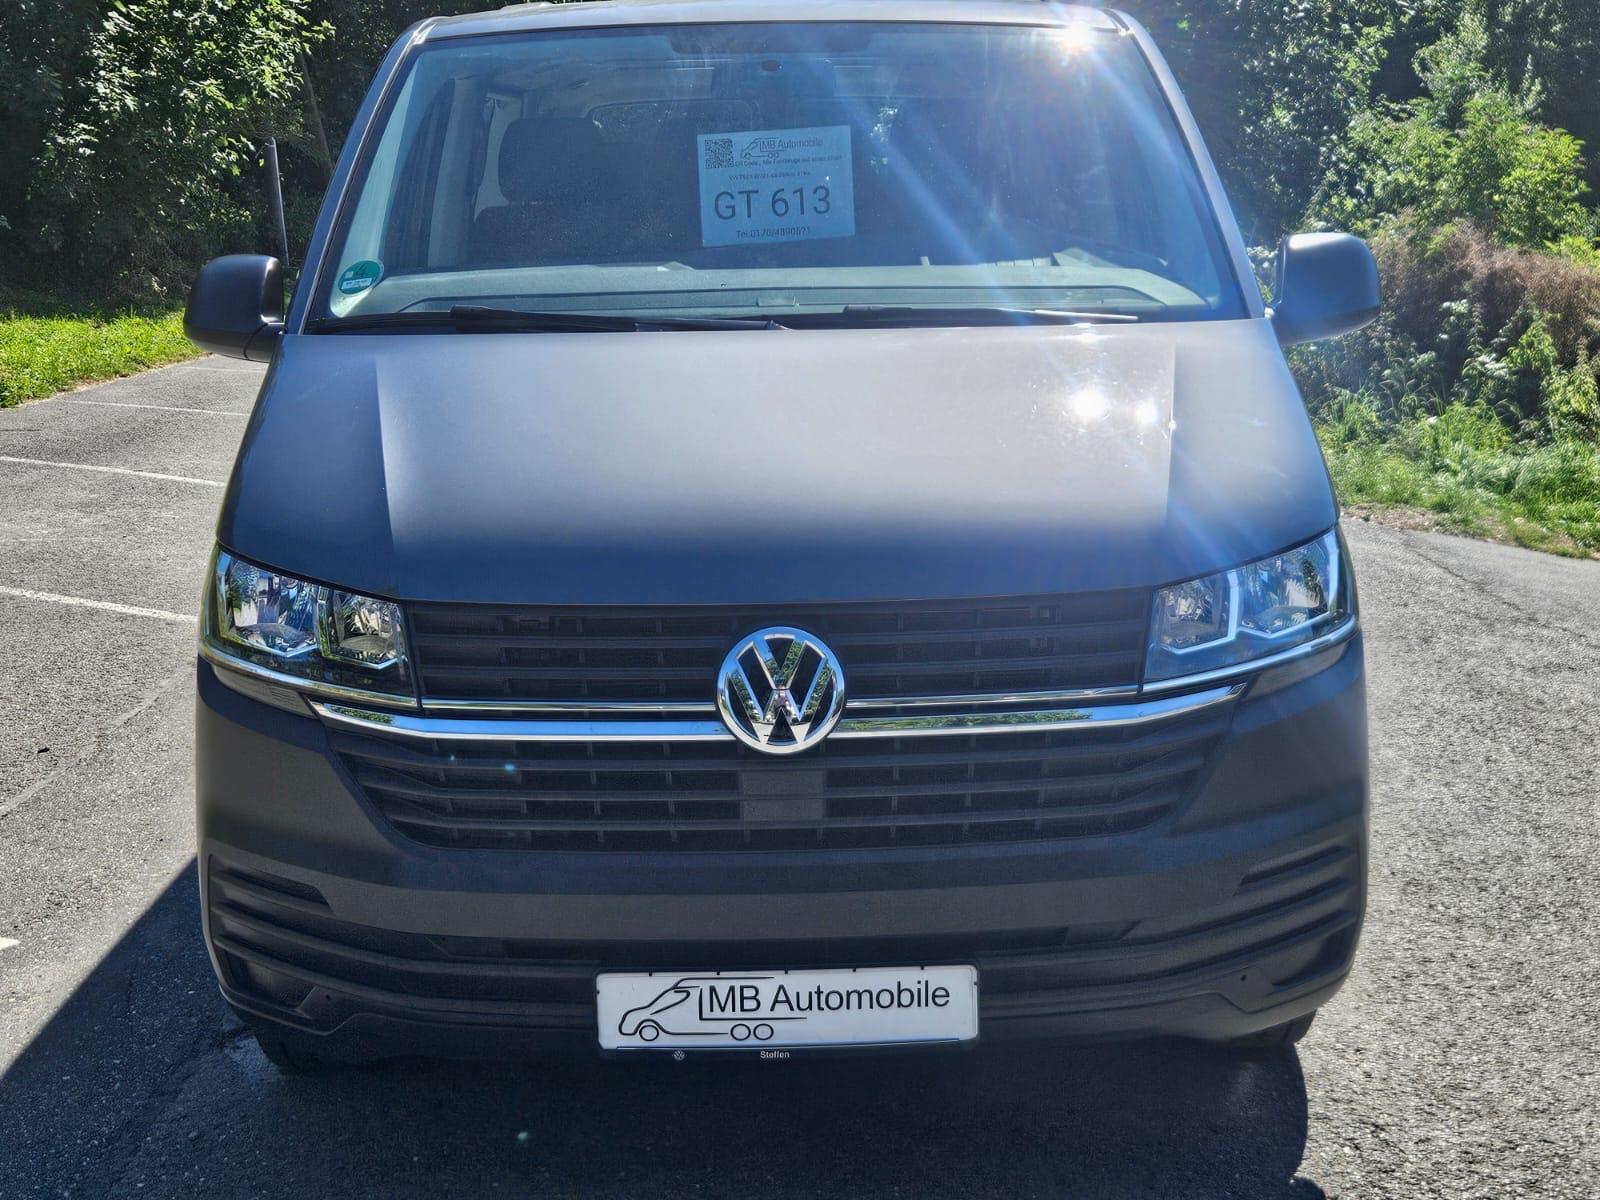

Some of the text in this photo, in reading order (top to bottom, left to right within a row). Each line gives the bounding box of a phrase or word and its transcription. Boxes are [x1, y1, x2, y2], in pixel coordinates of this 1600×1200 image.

[762, 137, 823, 149] MB Automobile
[714, 184, 831, 220] GT 613
[709, 980, 951, 1013] MB Automobile
